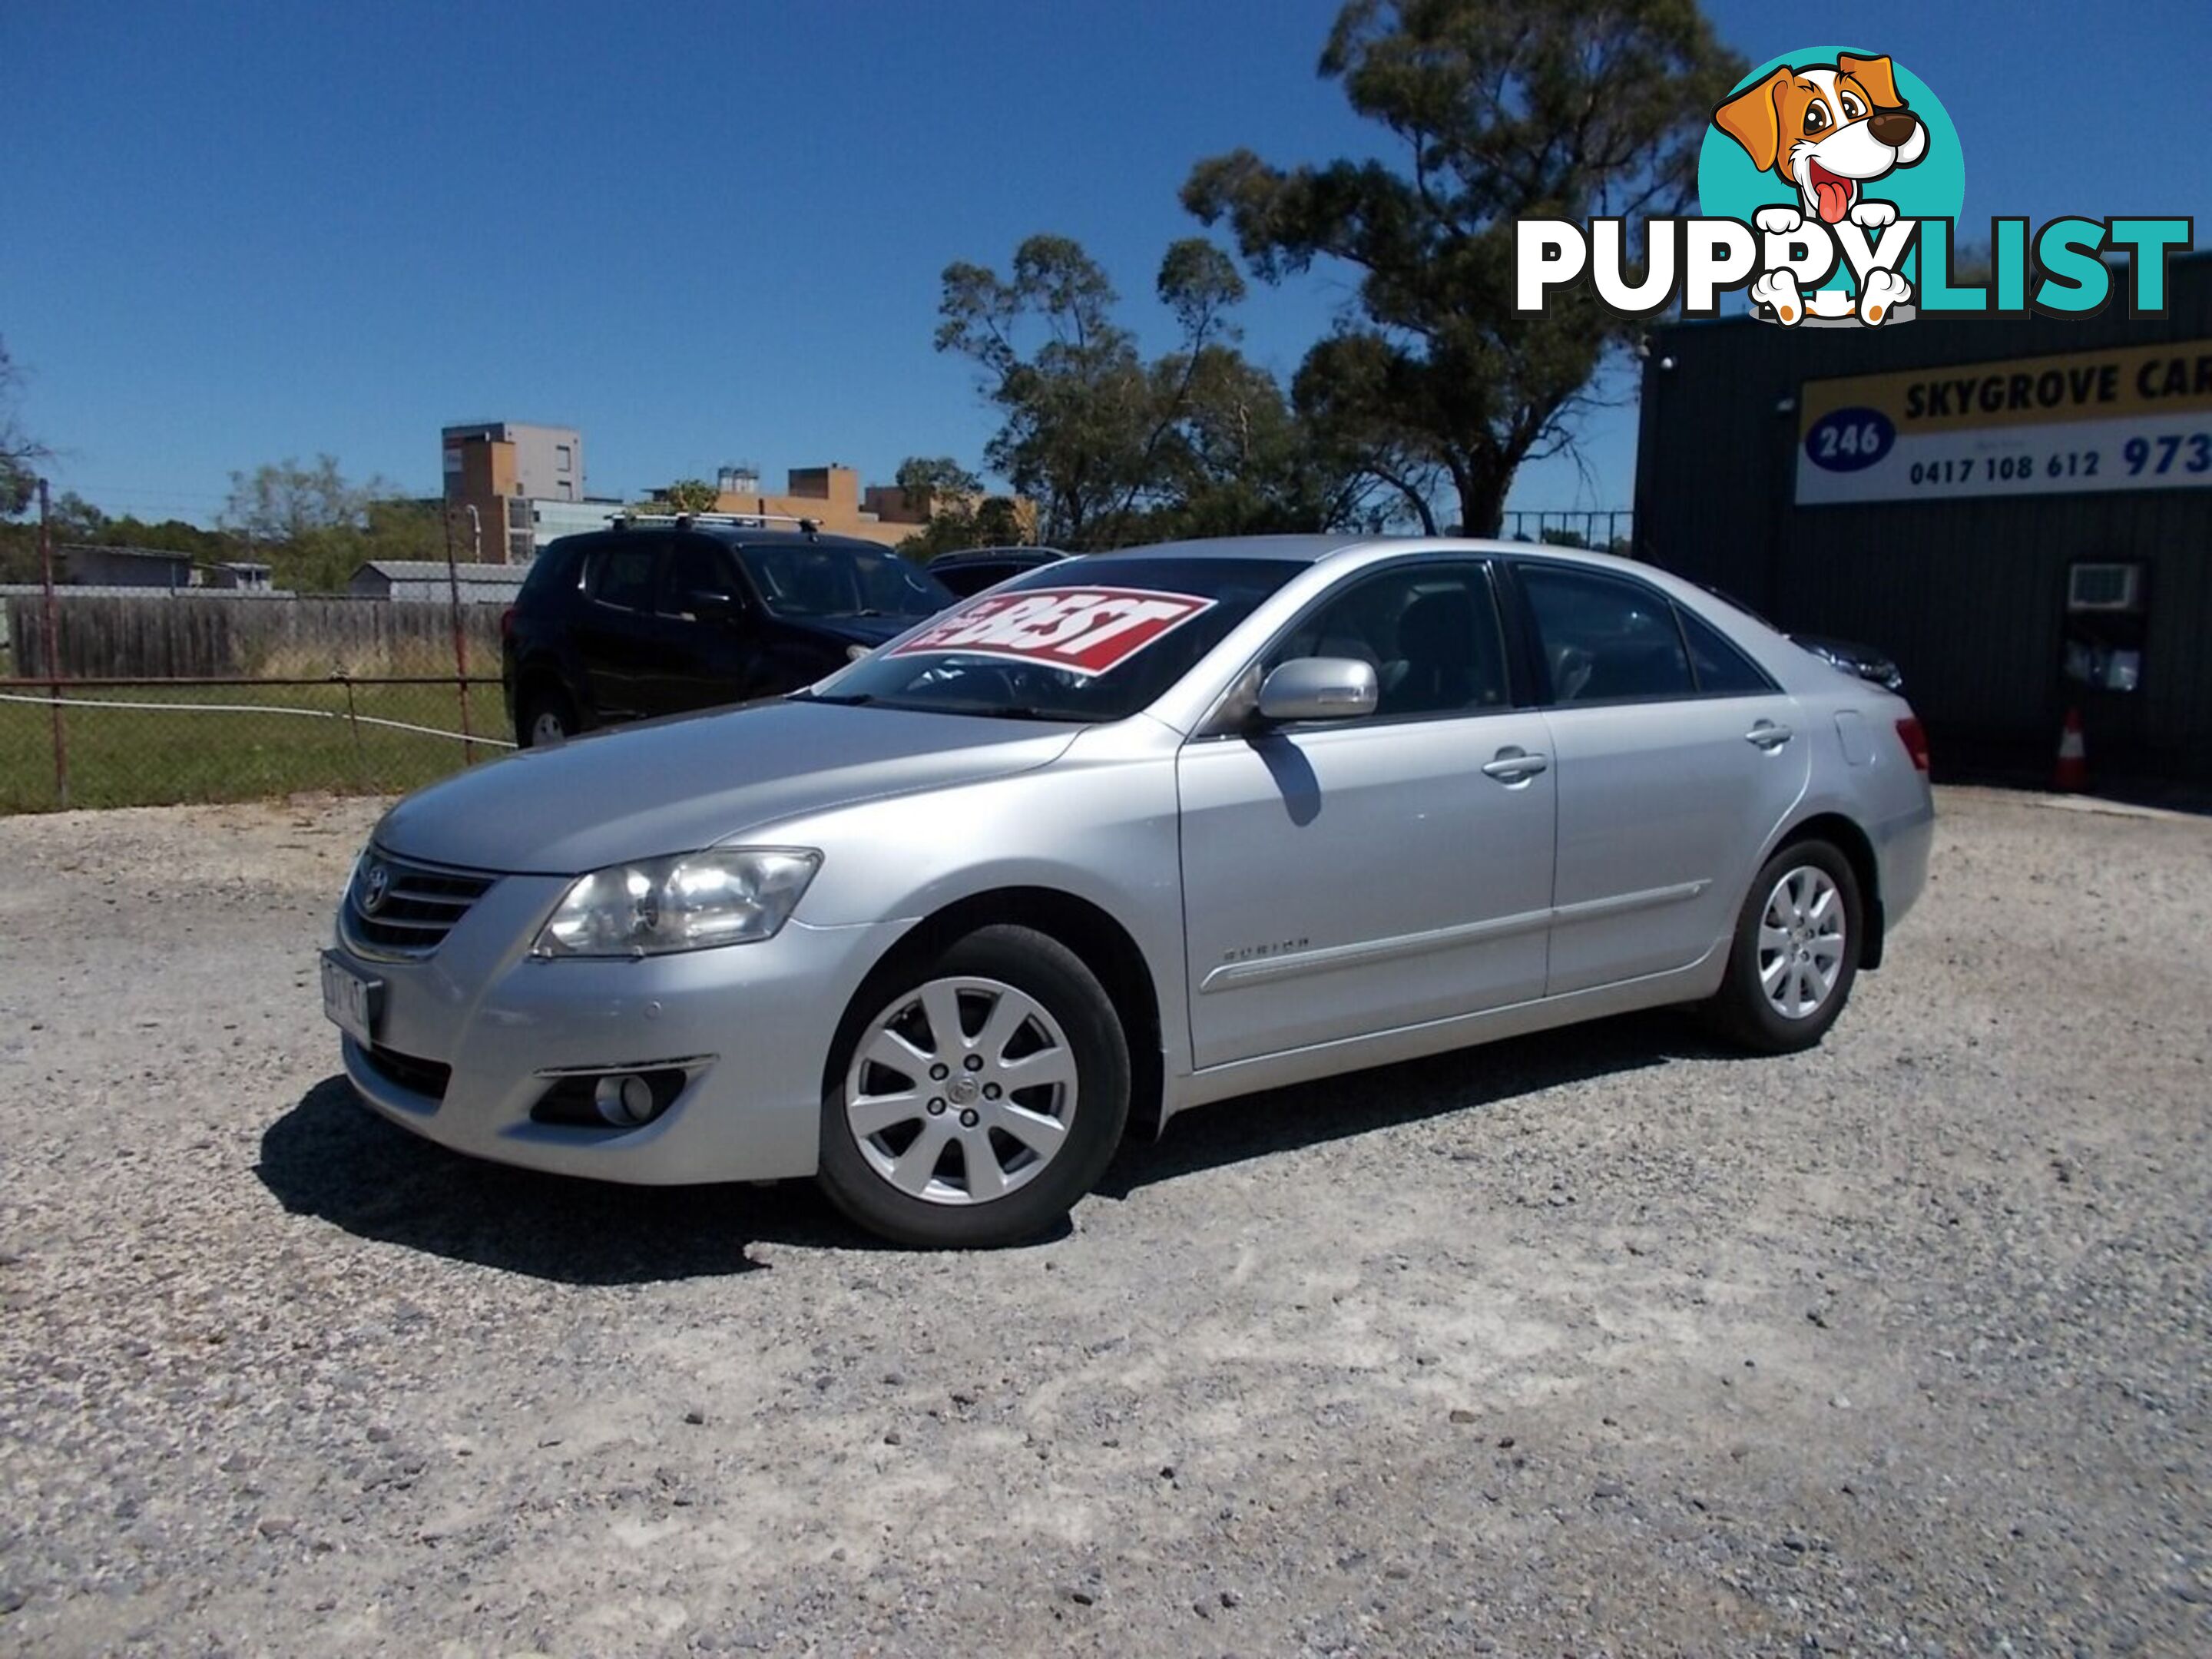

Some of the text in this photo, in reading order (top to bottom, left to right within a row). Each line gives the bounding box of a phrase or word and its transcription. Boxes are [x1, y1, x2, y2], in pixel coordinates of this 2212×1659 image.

[1906, 364, 2120, 419] SKYGROVE
[1818, 422, 1880, 459] 246
[1909, 433, 2212, 485] 0417 108 612 973
[938, 595, 1194, 654] BEST
